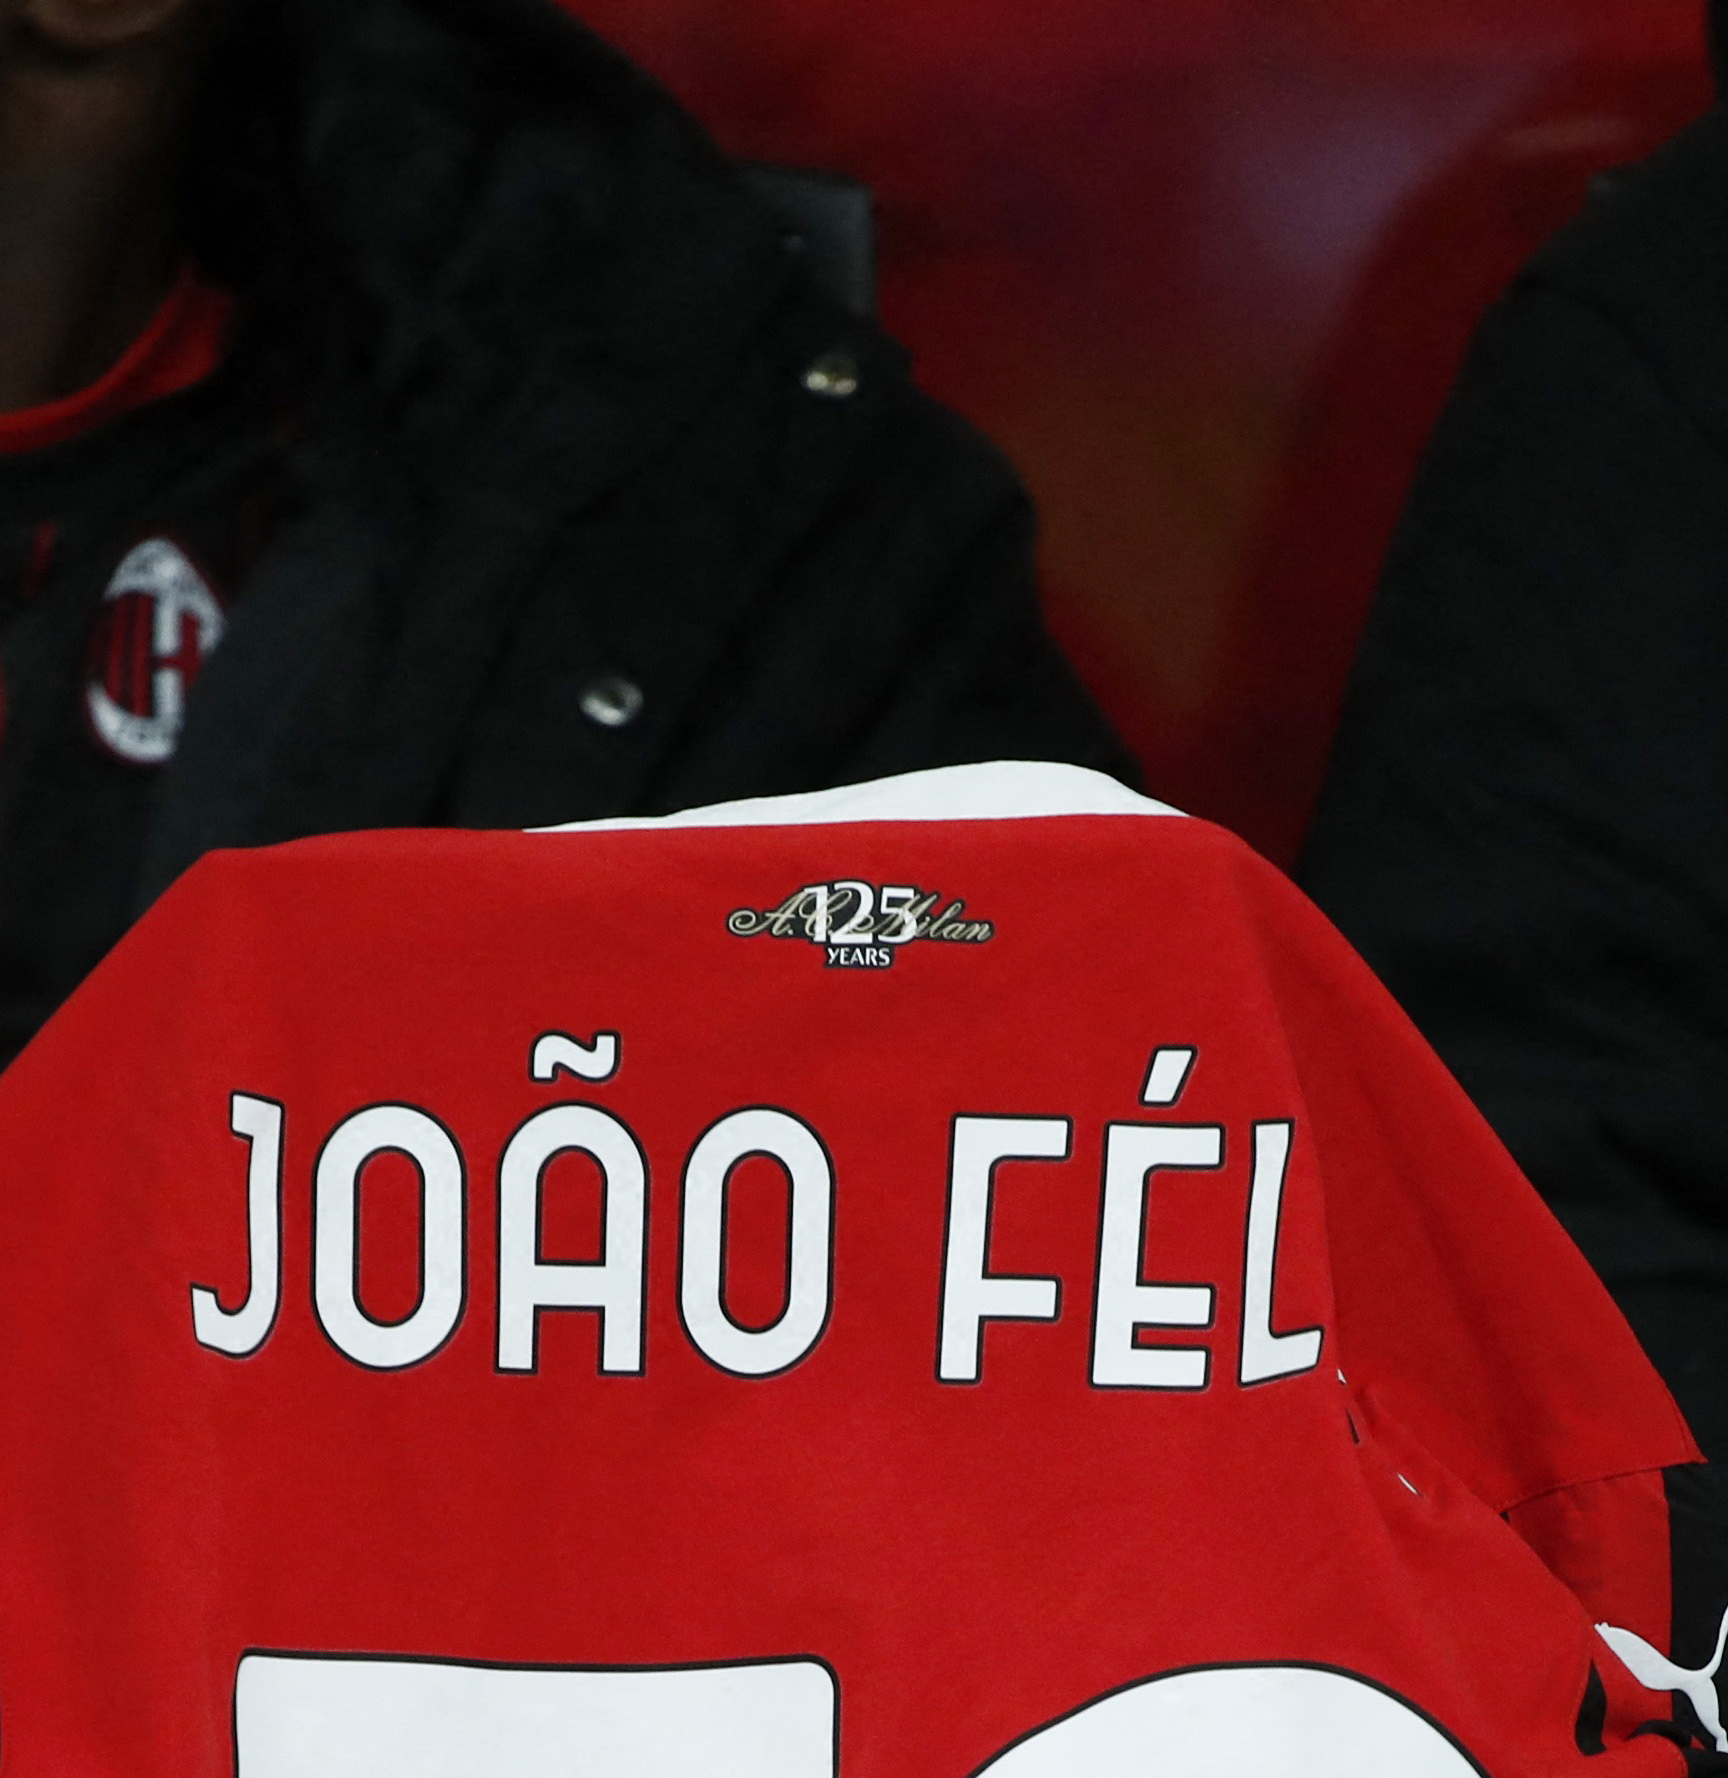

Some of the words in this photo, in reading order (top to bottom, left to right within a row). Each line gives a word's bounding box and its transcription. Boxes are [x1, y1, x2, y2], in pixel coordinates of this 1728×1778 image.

[804, 881, 918, 943] 125
[827, 947, 891, 967] YEARS
[190, 1029, 838, 1381] JOÃO
